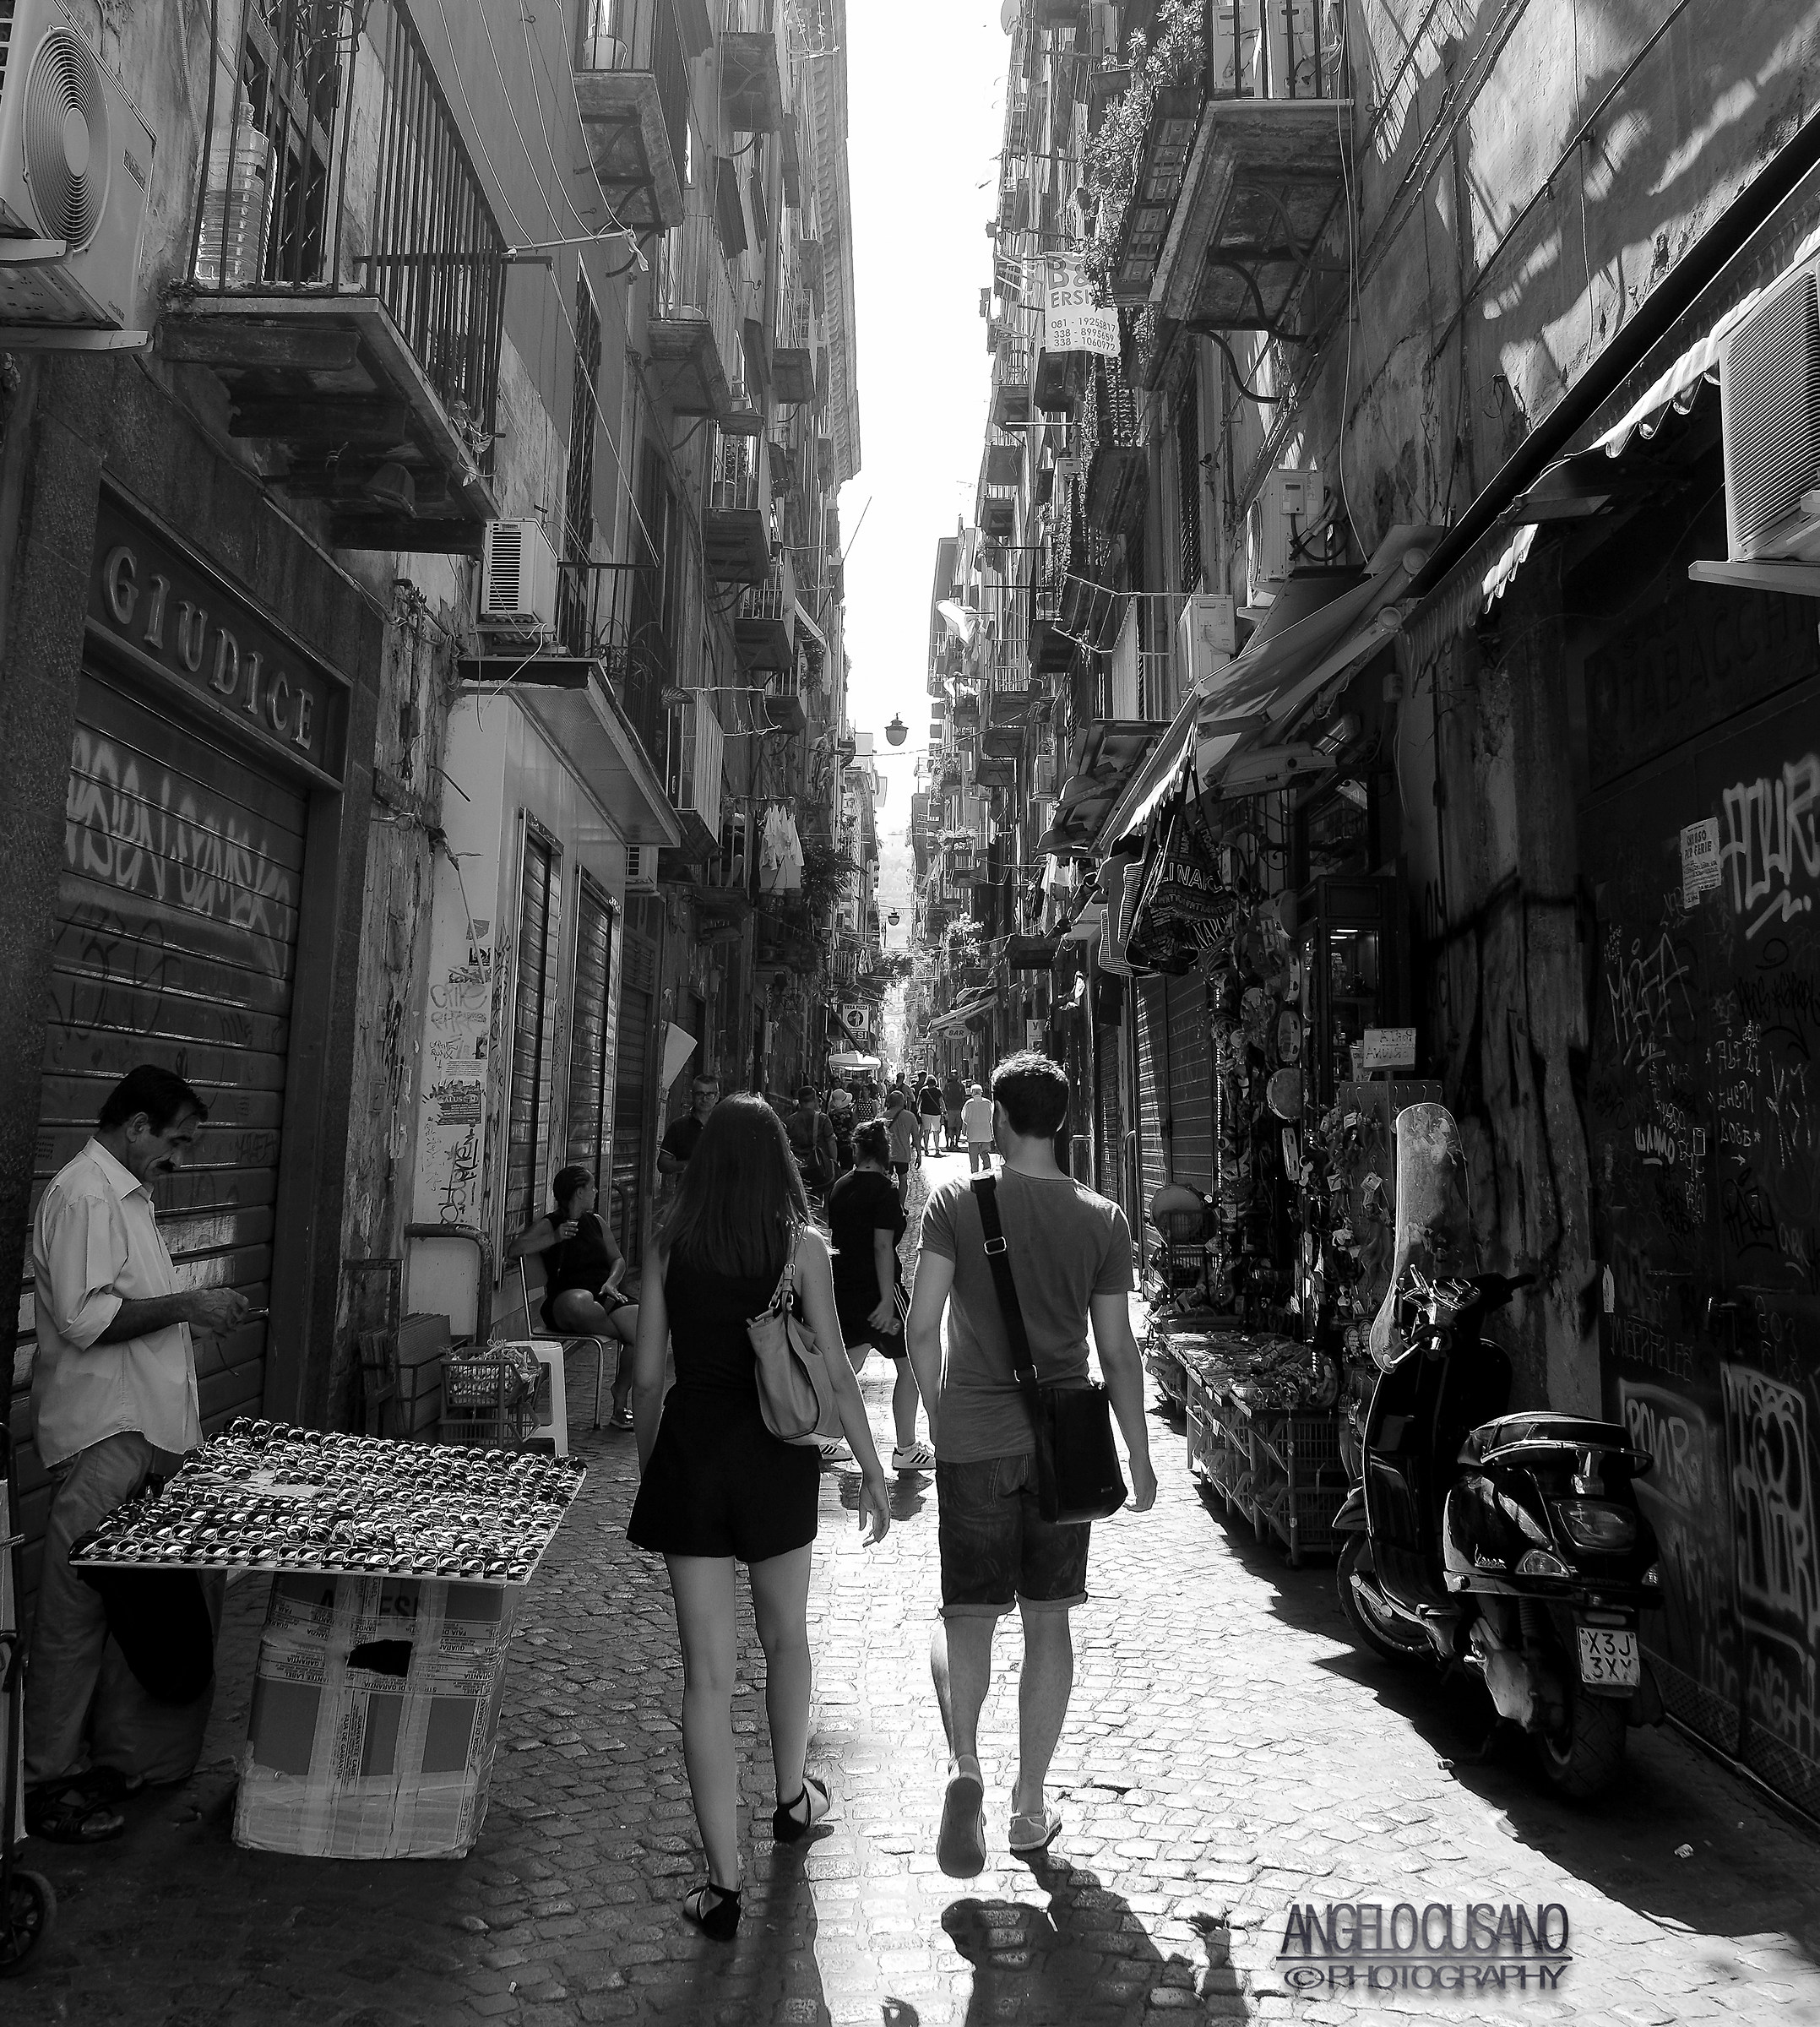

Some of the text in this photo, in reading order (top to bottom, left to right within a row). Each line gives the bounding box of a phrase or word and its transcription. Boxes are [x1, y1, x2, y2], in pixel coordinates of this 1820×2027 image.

[1051, 290, 1090, 308] ERSI
[1051, 319, 1067, 329] 081
[1054, 329, 1071, 338] 338
[1054, 338, 1072, 346] 338
[1082, 337, 1116, 351] 1060972
[103, 546, 313, 750] GIUDICE
[1587, 1631, 1631, 1656] X3J
